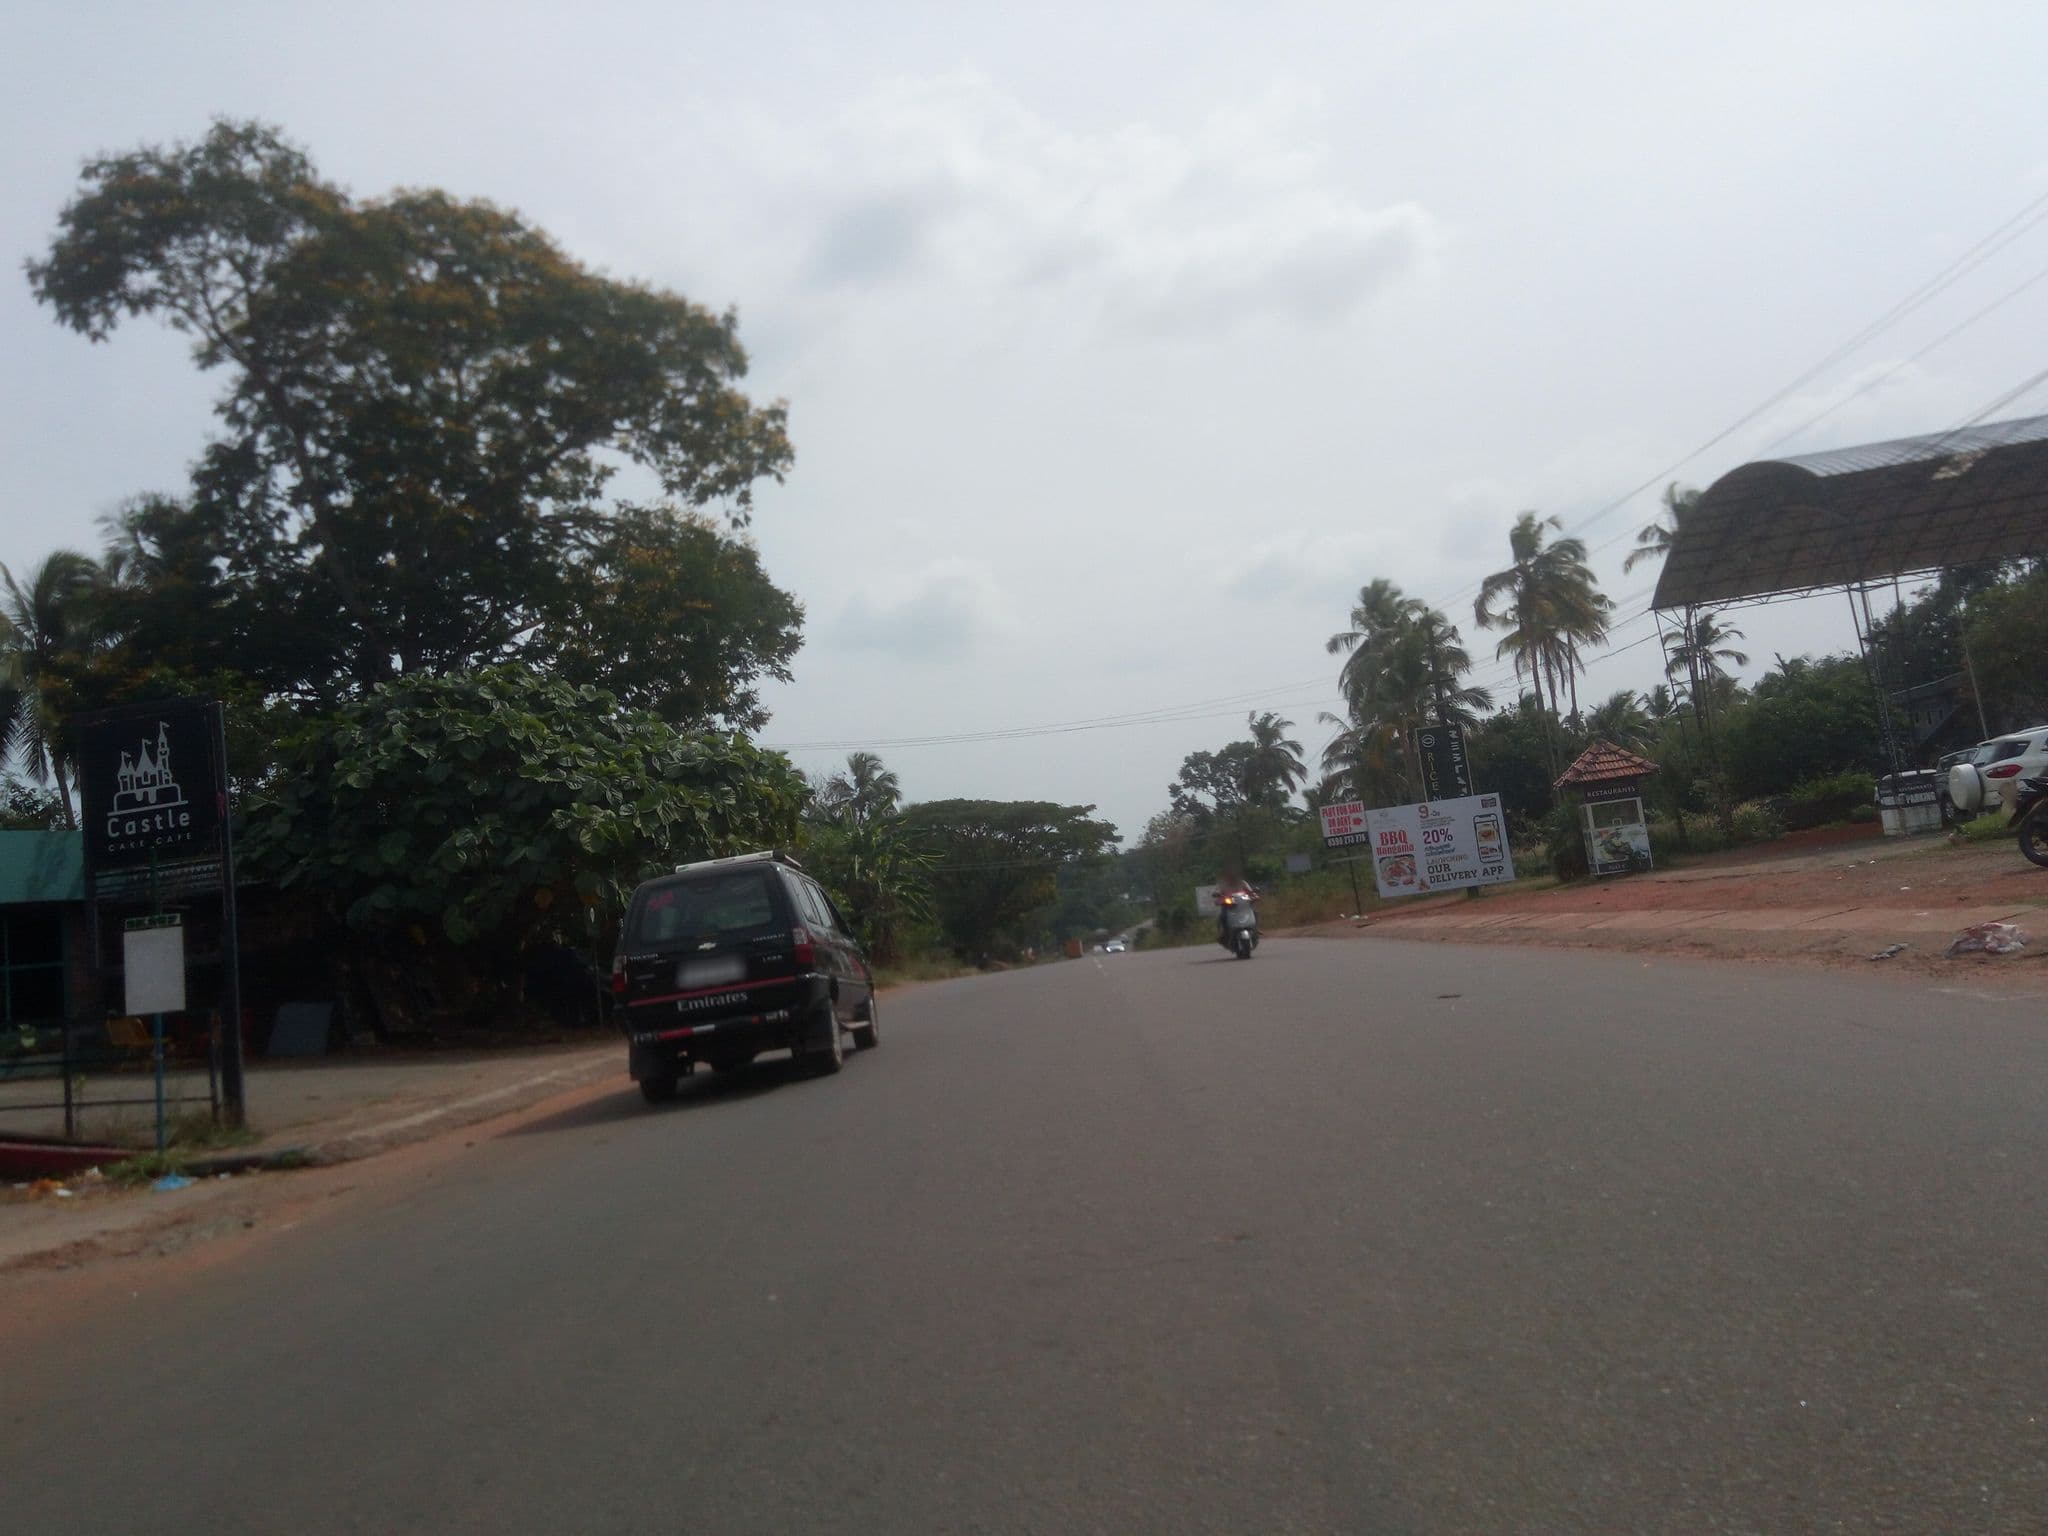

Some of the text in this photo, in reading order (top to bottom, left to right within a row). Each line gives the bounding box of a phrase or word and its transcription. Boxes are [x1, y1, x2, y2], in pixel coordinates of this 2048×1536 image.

[1427, 752, 1440, 791] RICE
[1586, 785, 1636, 797] RESTAURANTS
[1336, 805, 1348, 815] FOR
[107, 808, 190, 838] Castle
[1379, 829, 1409, 846] BBQ
[1423, 827, 1454, 844] 20%
[1427, 863, 1452, 875] OUR
[1429, 865, 1505, 884] DELIVERY APP
[676, 990, 748, 1012] Emirates
